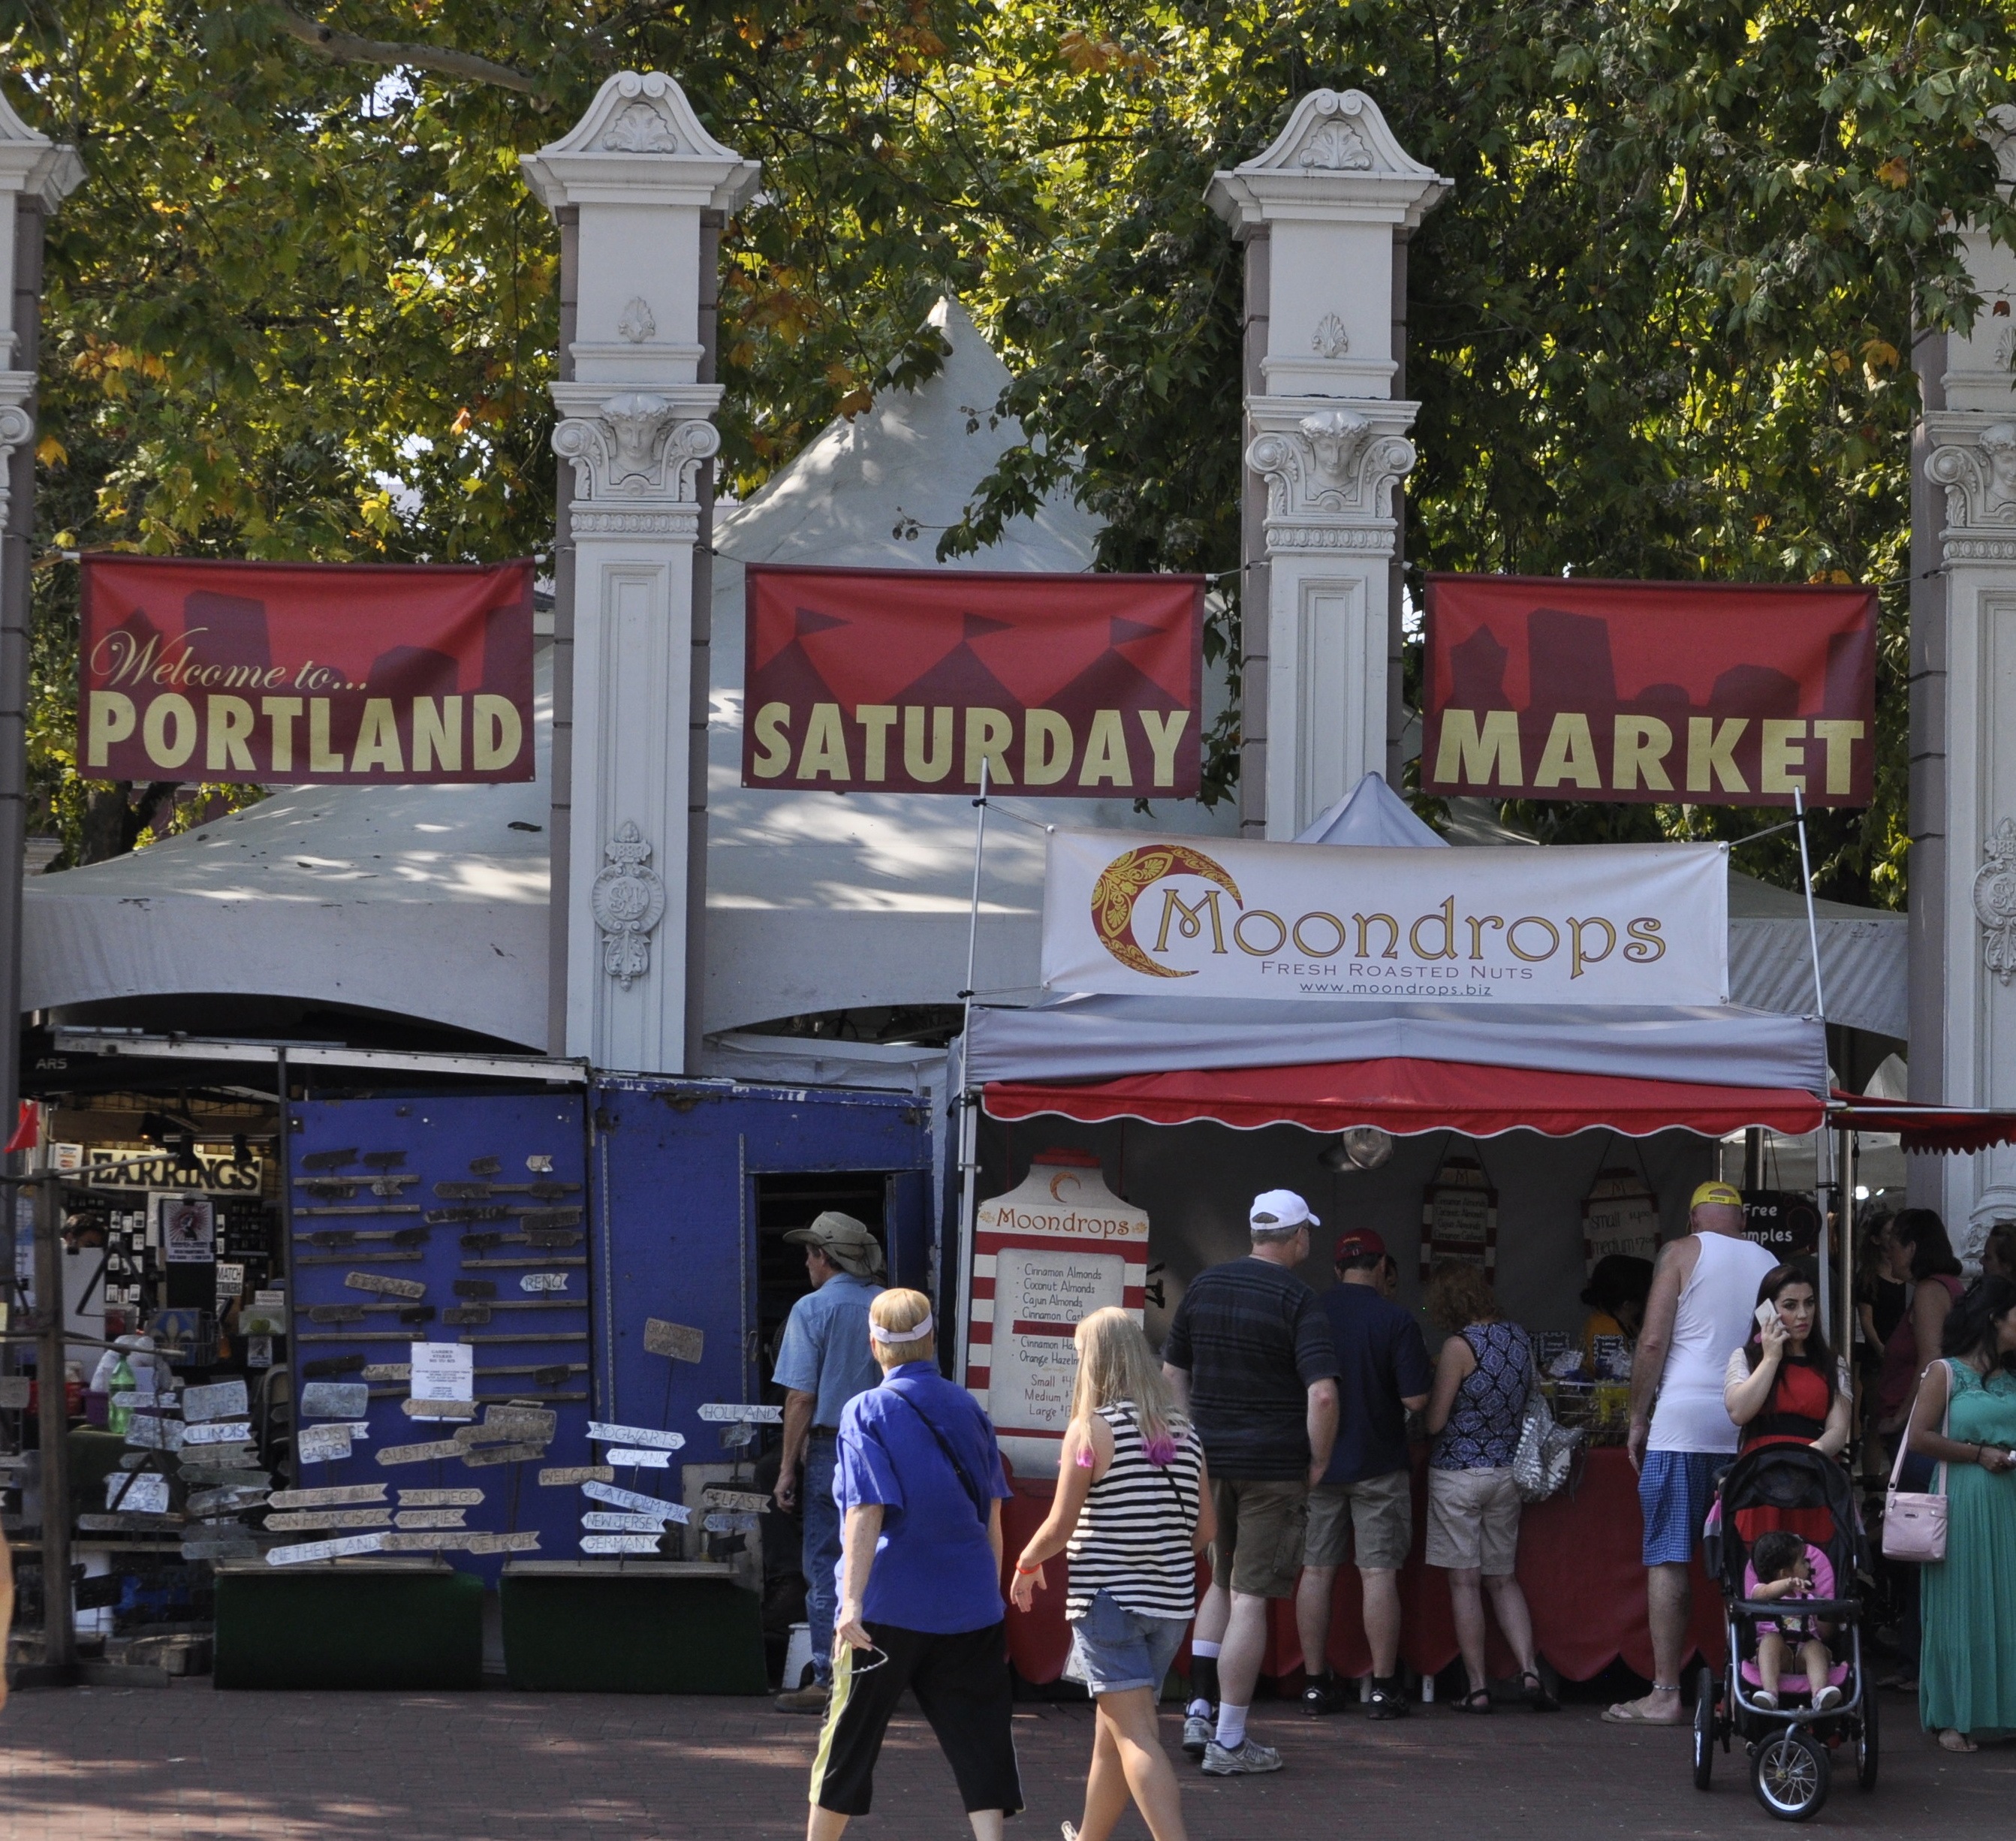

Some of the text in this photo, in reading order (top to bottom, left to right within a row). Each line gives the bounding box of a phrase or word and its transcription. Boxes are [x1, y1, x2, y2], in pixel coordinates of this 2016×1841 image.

[90, 628, 367, 691] Welcome to...
[87, 690, 523, 772] PORTLAND
[753, 701, 1191, 788] SATURDAY
[1433, 709, 1864, 795] MARKET
[1152, 889, 1666, 980] Moondrops
[1261, 961, 1532, 981] FRESH ROASTED NUTS
[1300, 981, 1493, 997] www.moondrops.biz
[93, 1153, 260, 1190] EARRINGS
[1742, 1203, 1778, 1217] Free
[996, 1208, 1130, 1239] Moondrops
[1024, 1263, 1102, 1280] Cinnamon Almonds
[525, 1273, 563, 1289] RENO
[1023, 1278, 1095, 1294] Coconut Almonds
[1022, 1292, 1083, 1308] Cajun Almonds
[1022, 1306, 1086, 1322] Cinnamon Cash
[1020, 1336, 1059, 1350] Cinnamon
[1019, 1350, 1078, 1367] Orange Hazeln
[1031, 1374, 1055, 1388] Small
[1024, 1388, 1061, 1403] Medium
[704, 1406, 778, 1420] HOLLAND
[1029, 1403, 1056, 1421] Large
[188, 1424, 245, 1441] ILLINOIS
[592, 1424, 680, 1448] HOGWARTS
[302, 1442, 350, 1460] GARDEN
[382, 1442, 471, 1461] AUSTRALIA
[610, 1451, 666, 1465] ENGLAND
[542, 1467, 610, 1483] WELCOME
[402, 1489, 481, 1505] SAN DIEGO
[586, 1482, 661, 1514] PLATFORM
[704, 1490, 766, 1510] BELFAST
[269, 1510, 387, 1529] SAN FRANCISCO
[398, 1512, 460, 1526] ZOMBIES
[586, 1514, 664, 1529] NEW JERSEY
[470, 1532, 535, 1551] DETROIT
[586, 1536, 656, 1550] GERMANY
